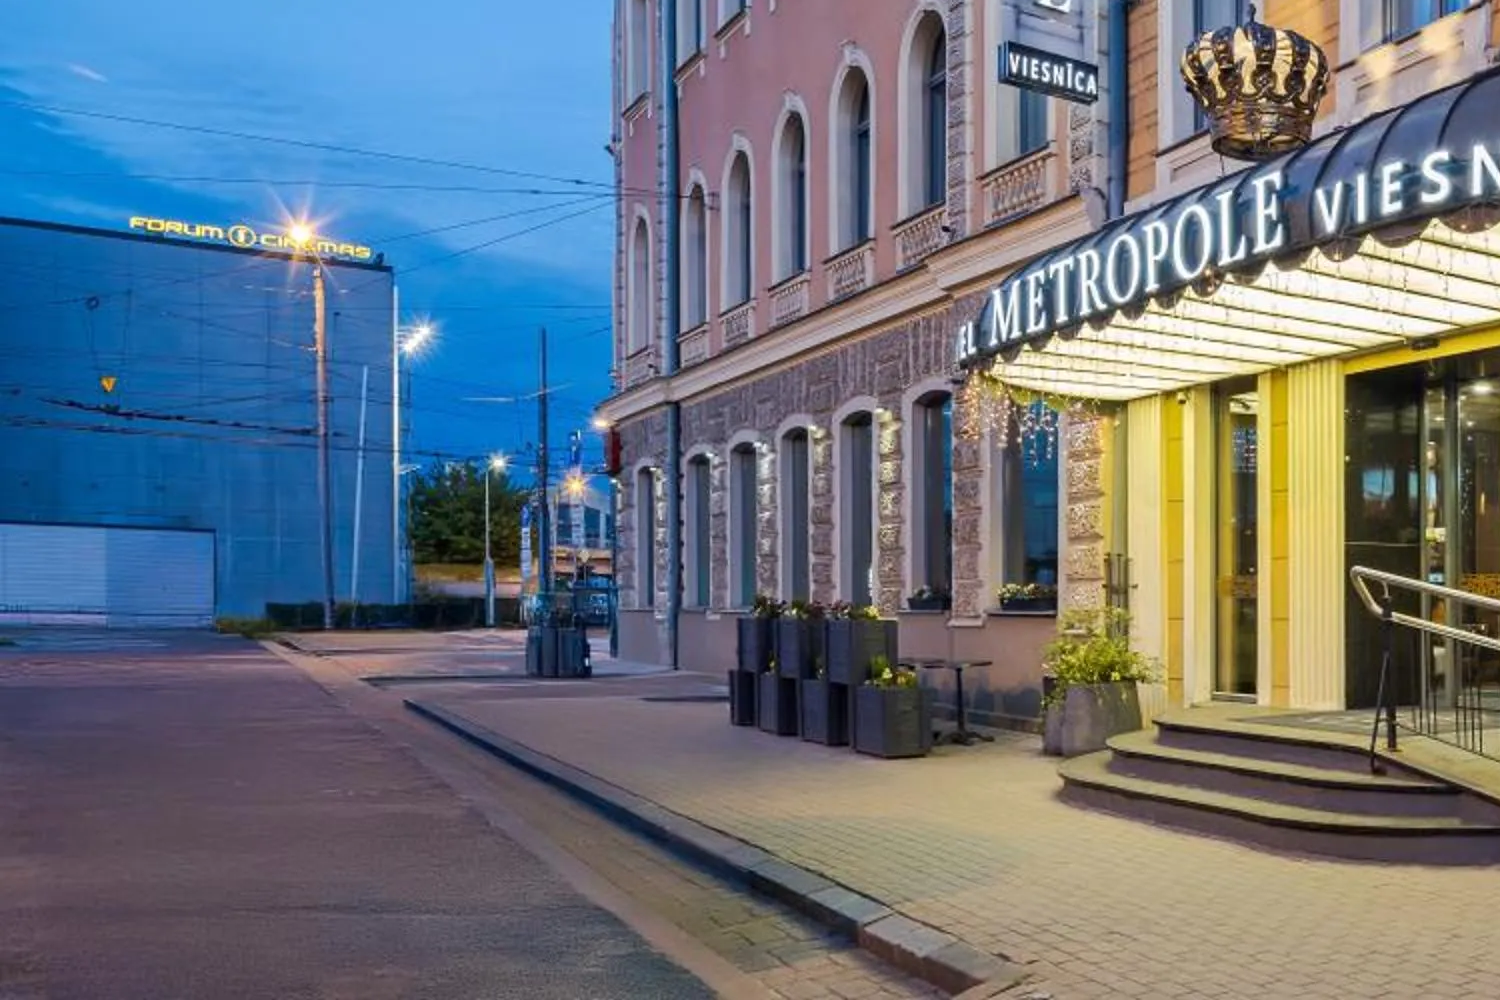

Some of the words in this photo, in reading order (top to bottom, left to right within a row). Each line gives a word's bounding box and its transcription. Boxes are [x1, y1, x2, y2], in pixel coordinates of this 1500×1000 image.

[1009, 52, 1097, 95] VIESNĪCA
[129, 215, 224, 240] FORUM
[989, 170, 1283, 347] METROPOLE
